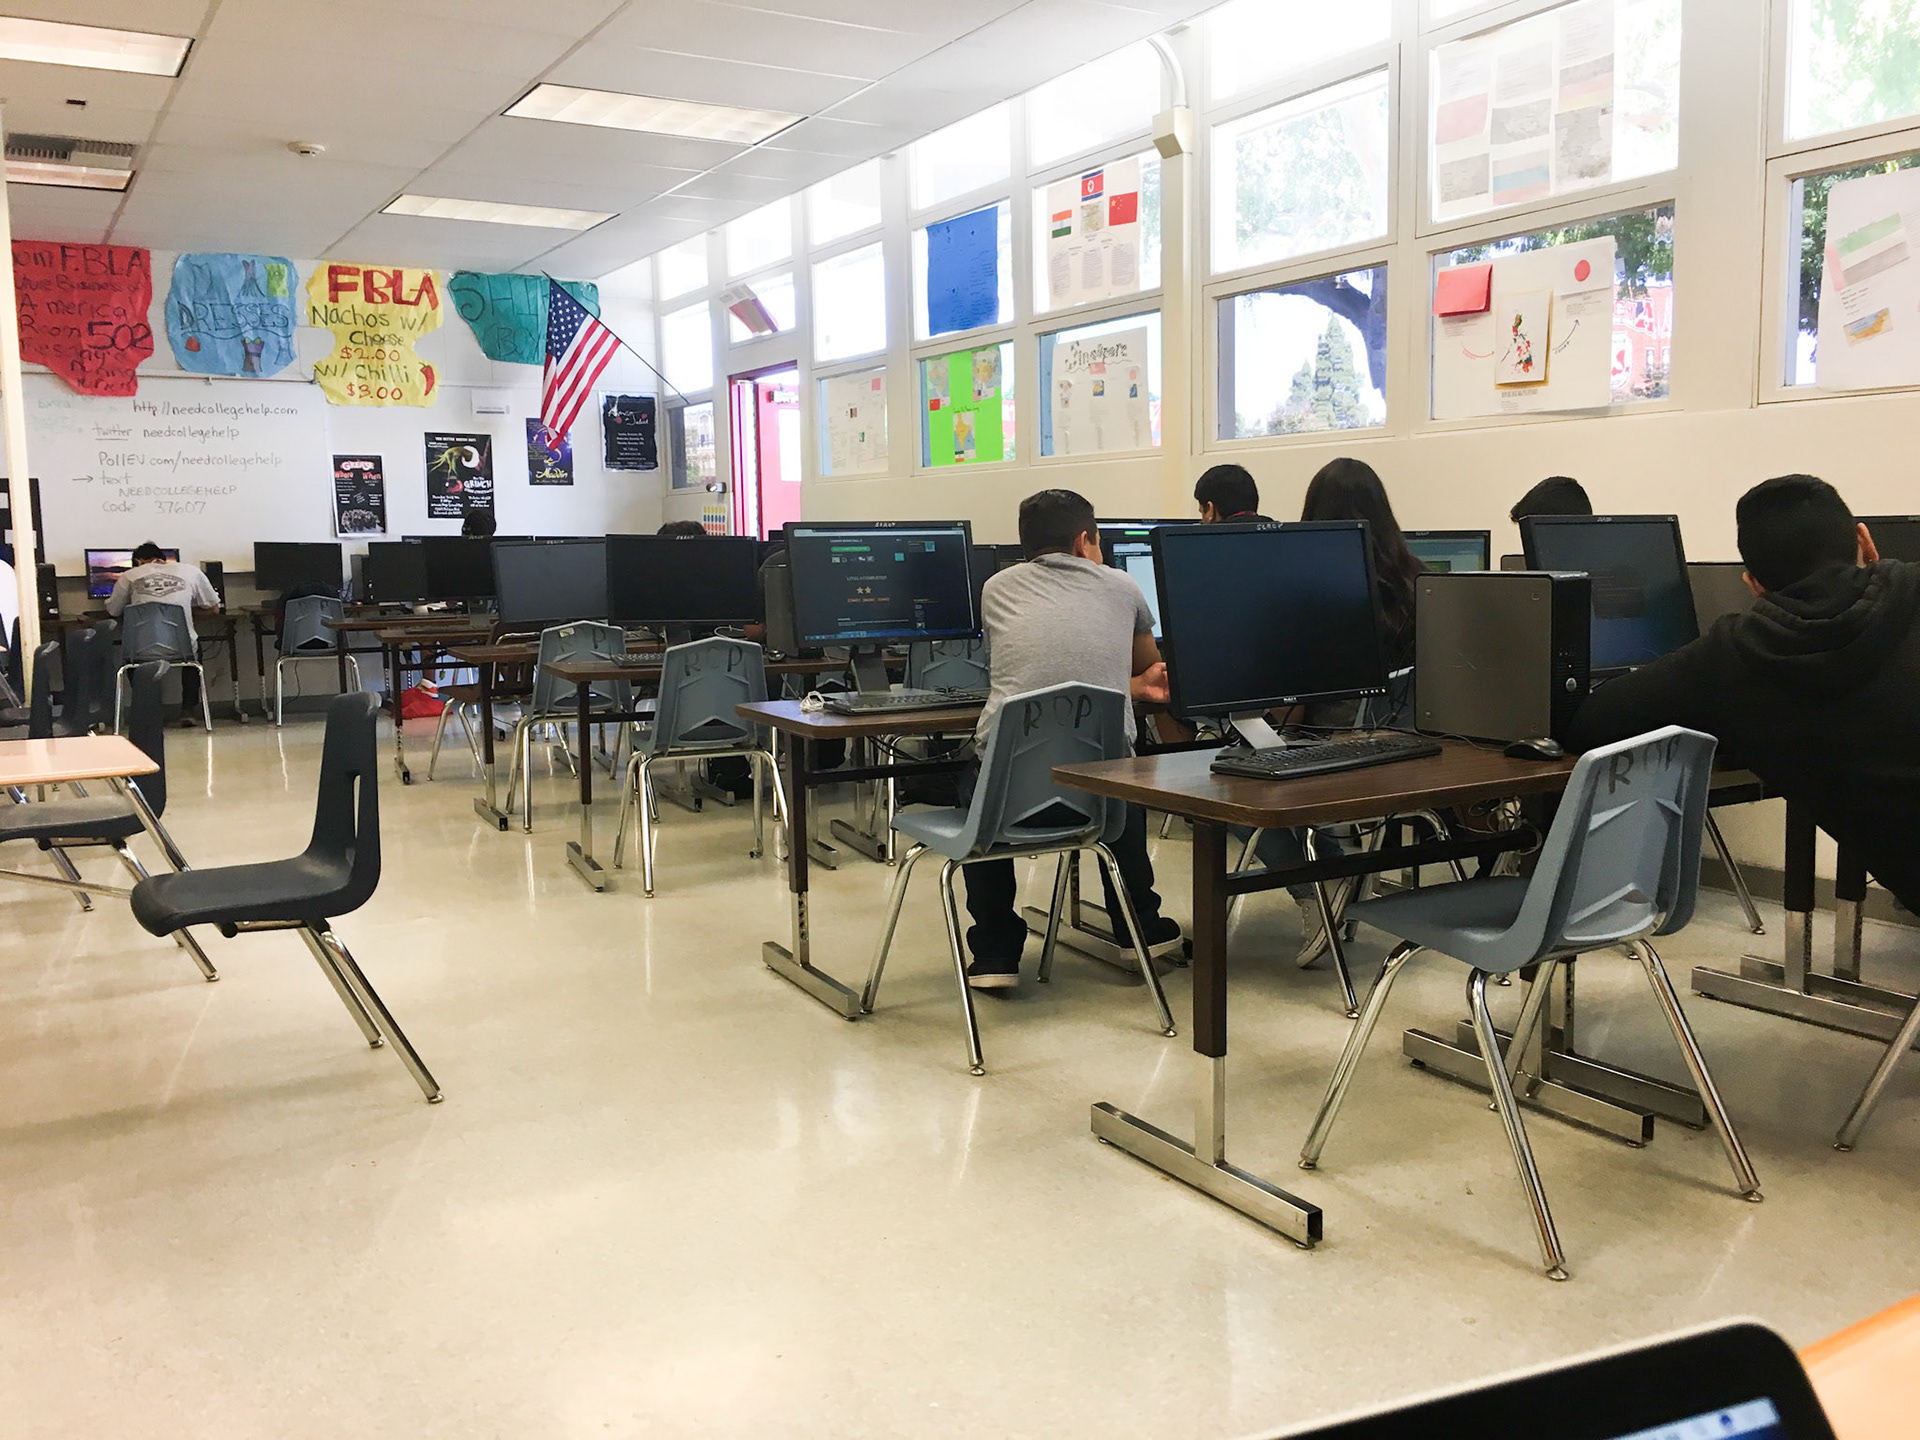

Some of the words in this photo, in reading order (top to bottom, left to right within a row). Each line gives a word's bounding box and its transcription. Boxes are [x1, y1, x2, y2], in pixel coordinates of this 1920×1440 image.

[12, 249, 53, 268] oin
[328, 265, 439, 311] FBLA
[177, 301, 289, 332] DRESSES
[312, 304, 390, 328] Nachos
[88, 321, 154, 351] 502
[340, 345, 401, 362] $2.00
[355, 364, 409, 383] Chilli
[346, 382, 403, 401] $3.00
[143, 424, 240, 445] needcollegehelp
[341, 460, 375, 471] GREASE
[535, 467, 568, 479] Aladdin
[99, 470, 132, 486] text
[464, 480, 492, 489] GRINCH
[118, 486, 238, 498] NEEDCOLLEGEHELP
[154, 500, 207, 515] 37607
[1023, 694, 1092, 737] ROP
[1608, 735, 1680, 796] ROP
